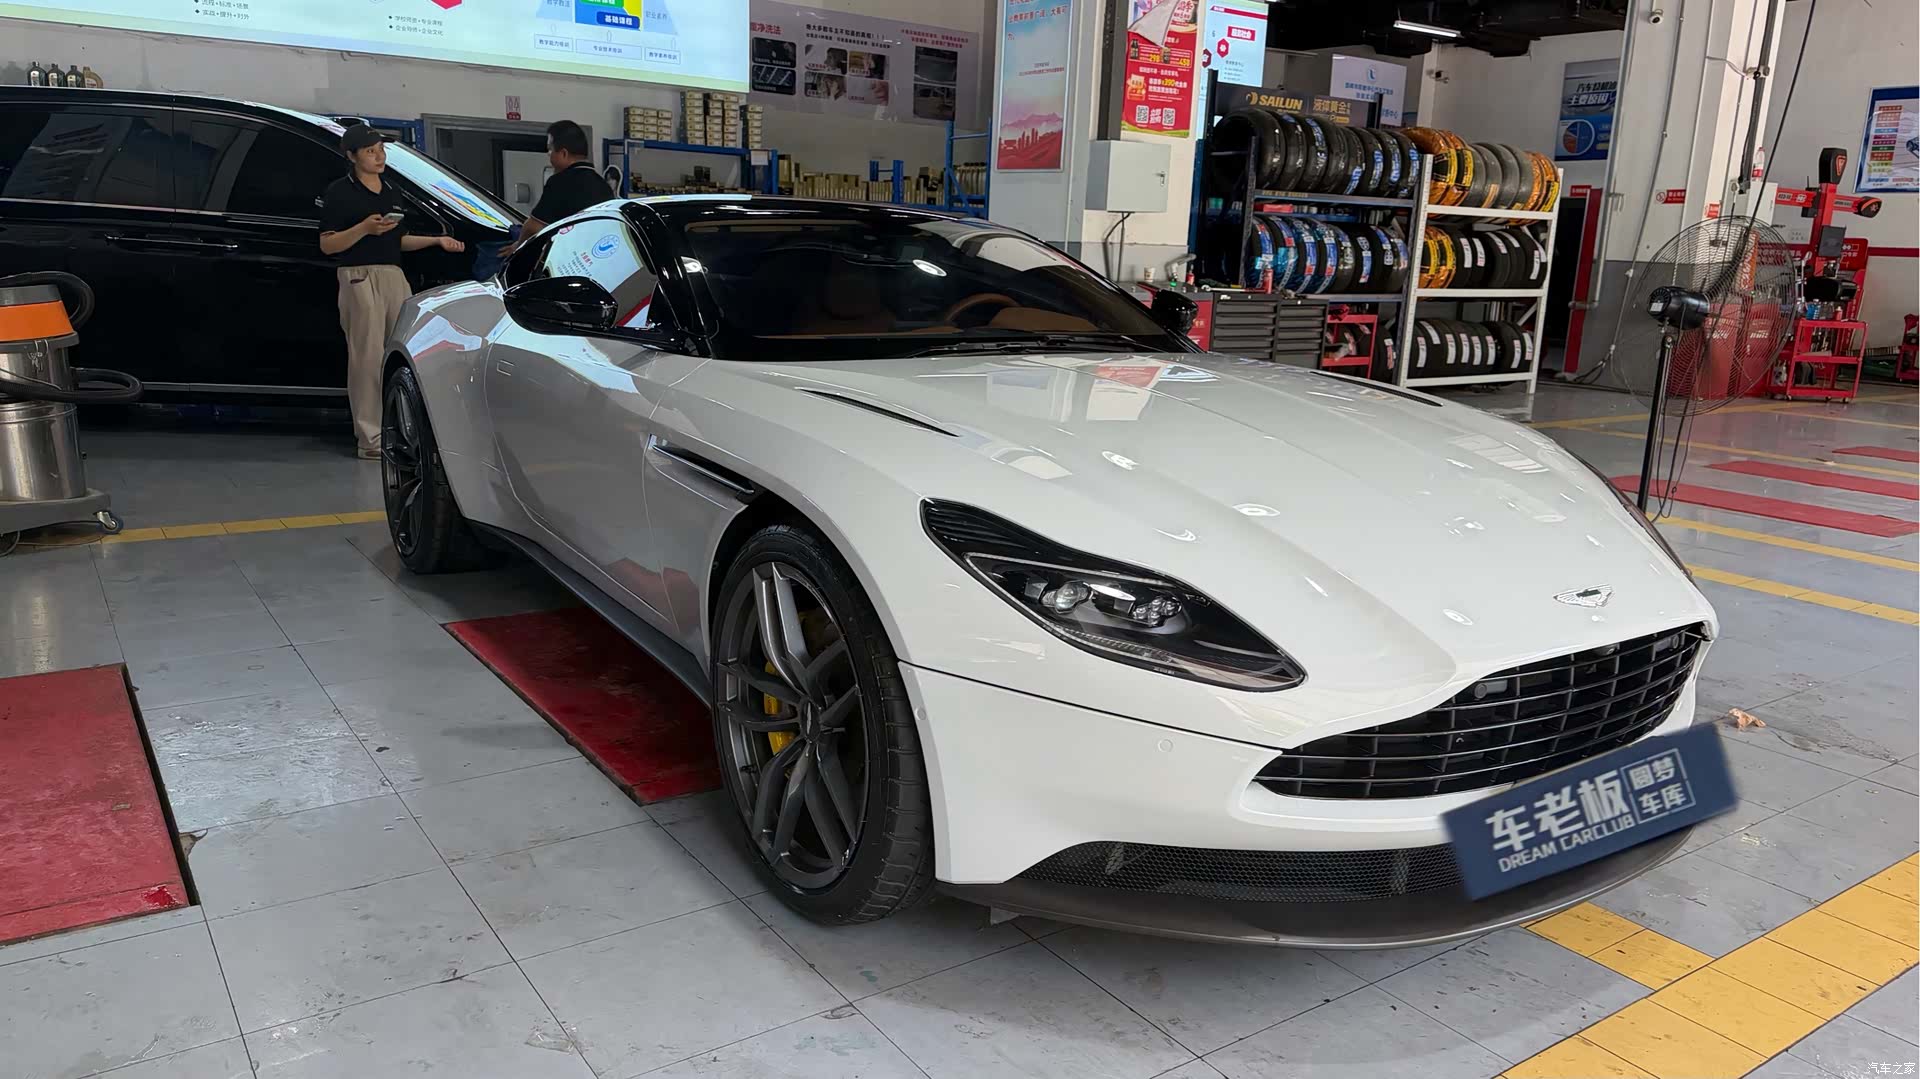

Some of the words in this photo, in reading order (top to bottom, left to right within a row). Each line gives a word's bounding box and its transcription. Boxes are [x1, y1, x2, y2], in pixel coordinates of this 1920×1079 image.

[604, 14, 633, 26] 基础课程
[1259, 94, 1304, 111] SAILUN
